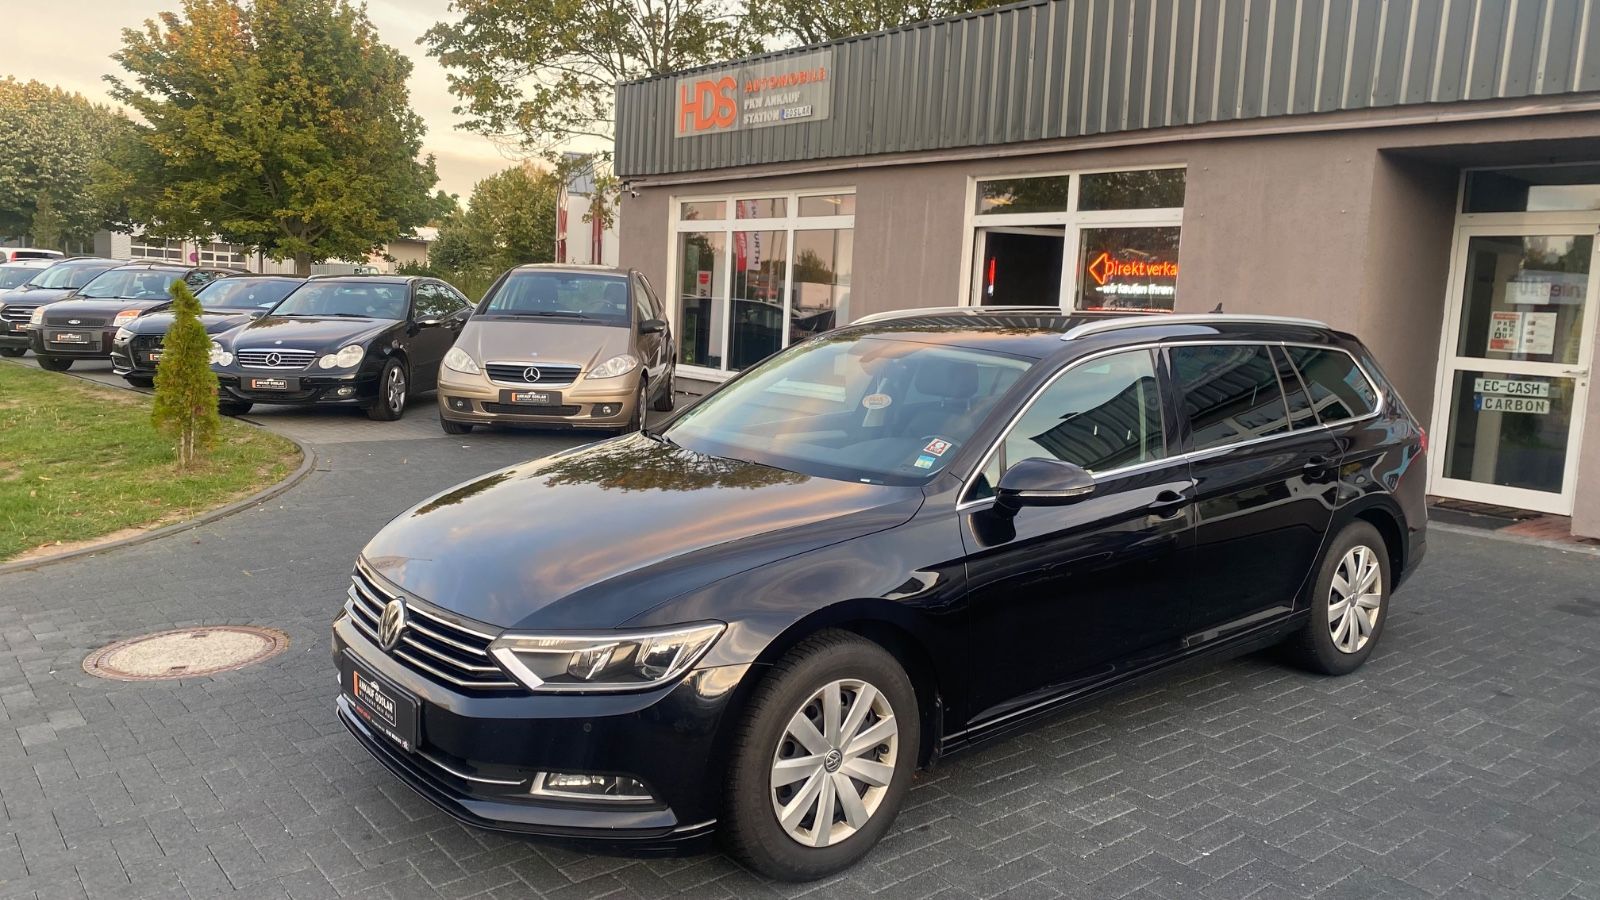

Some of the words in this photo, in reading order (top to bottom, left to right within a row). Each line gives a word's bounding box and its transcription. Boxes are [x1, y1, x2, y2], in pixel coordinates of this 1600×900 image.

[745, 68, 825, 92] AUTOMOBILE
[680, 76, 737, 134] HDS
[743, 98, 763, 110] PKW
[764, 91, 800, 107] ANKAUF
[743, 110, 779, 125] STATION
[1106, 260, 1145, 275] Direkt
[1483, 380, 1540, 394] EC-CASH
[1485, 398, 1545, 412] CARBON
